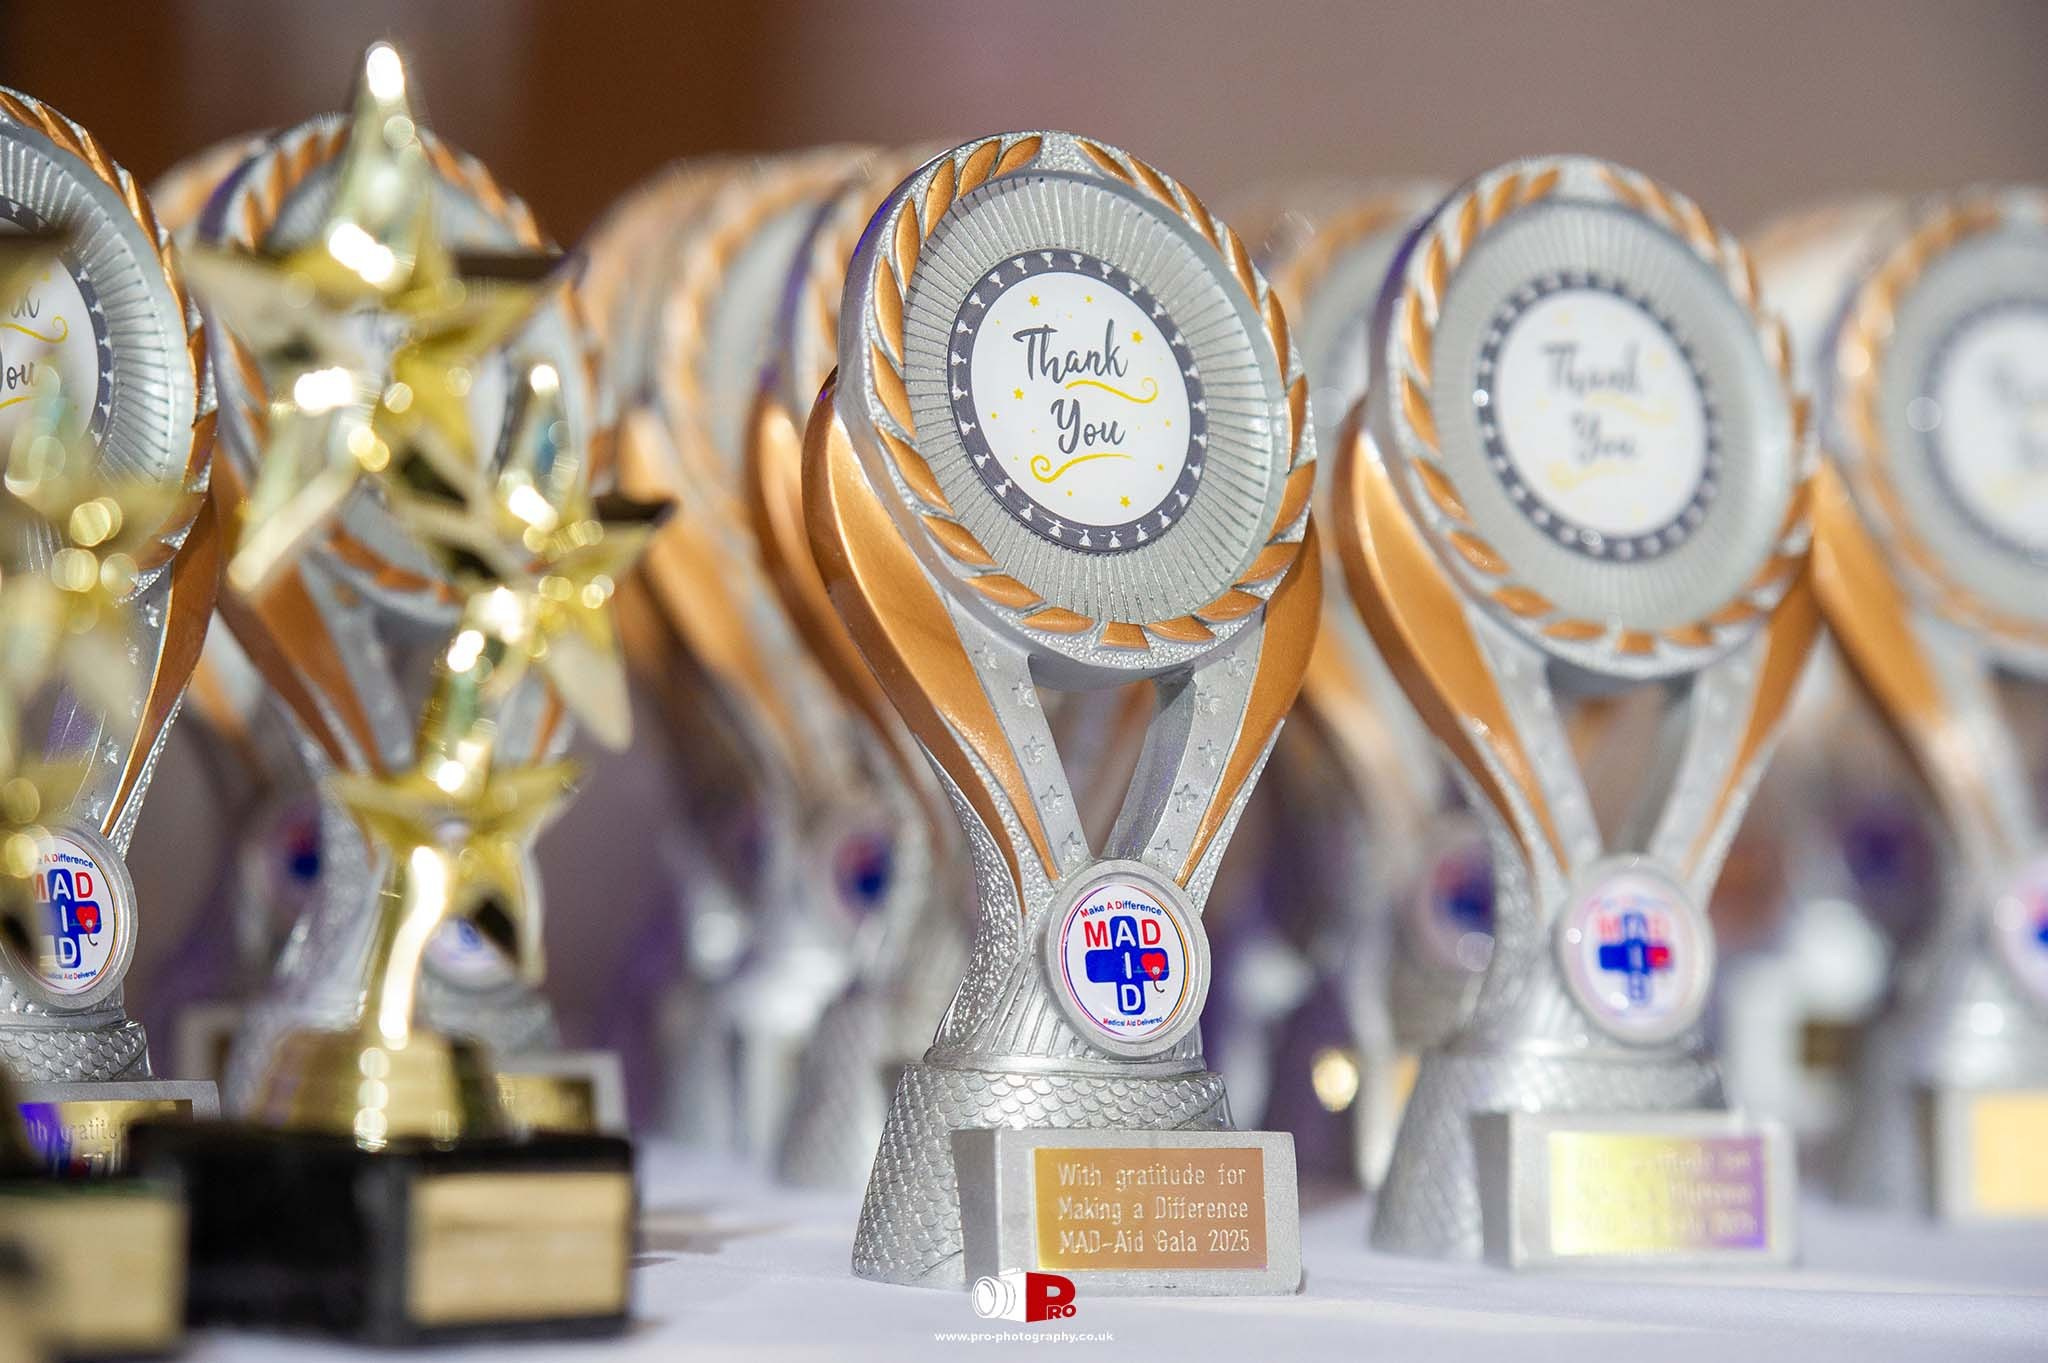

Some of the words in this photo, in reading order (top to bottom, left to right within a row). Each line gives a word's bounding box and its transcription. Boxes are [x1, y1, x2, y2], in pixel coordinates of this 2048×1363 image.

[1012, 318, 1128, 384] Thank
[1050, 399, 1126, 454] You
[51, 853, 94, 869] Difference
[1079, 904, 1105, 919] Make
[1106, 901, 1114, 911] A
[1115, 900, 1162, 916] Difference
[1083, 918, 1162, 948] MAD
[1057, 1162, 1102, 1186] With
[1115, 1162, 1205, 1191] gratitude
[1217, 1162, 1246, 1185] for
[1057, 1196, 1122, 1224] Making
[1132, 1202, 1144, 1219] a
[1154, 1196, 1249, 1219] Difference
[1058, 1229, 1144, 1254] MAD-Aid
[1156, 1229, 1198, 1252] Gala
[1207, 1229, 1250, 1252] 2025
